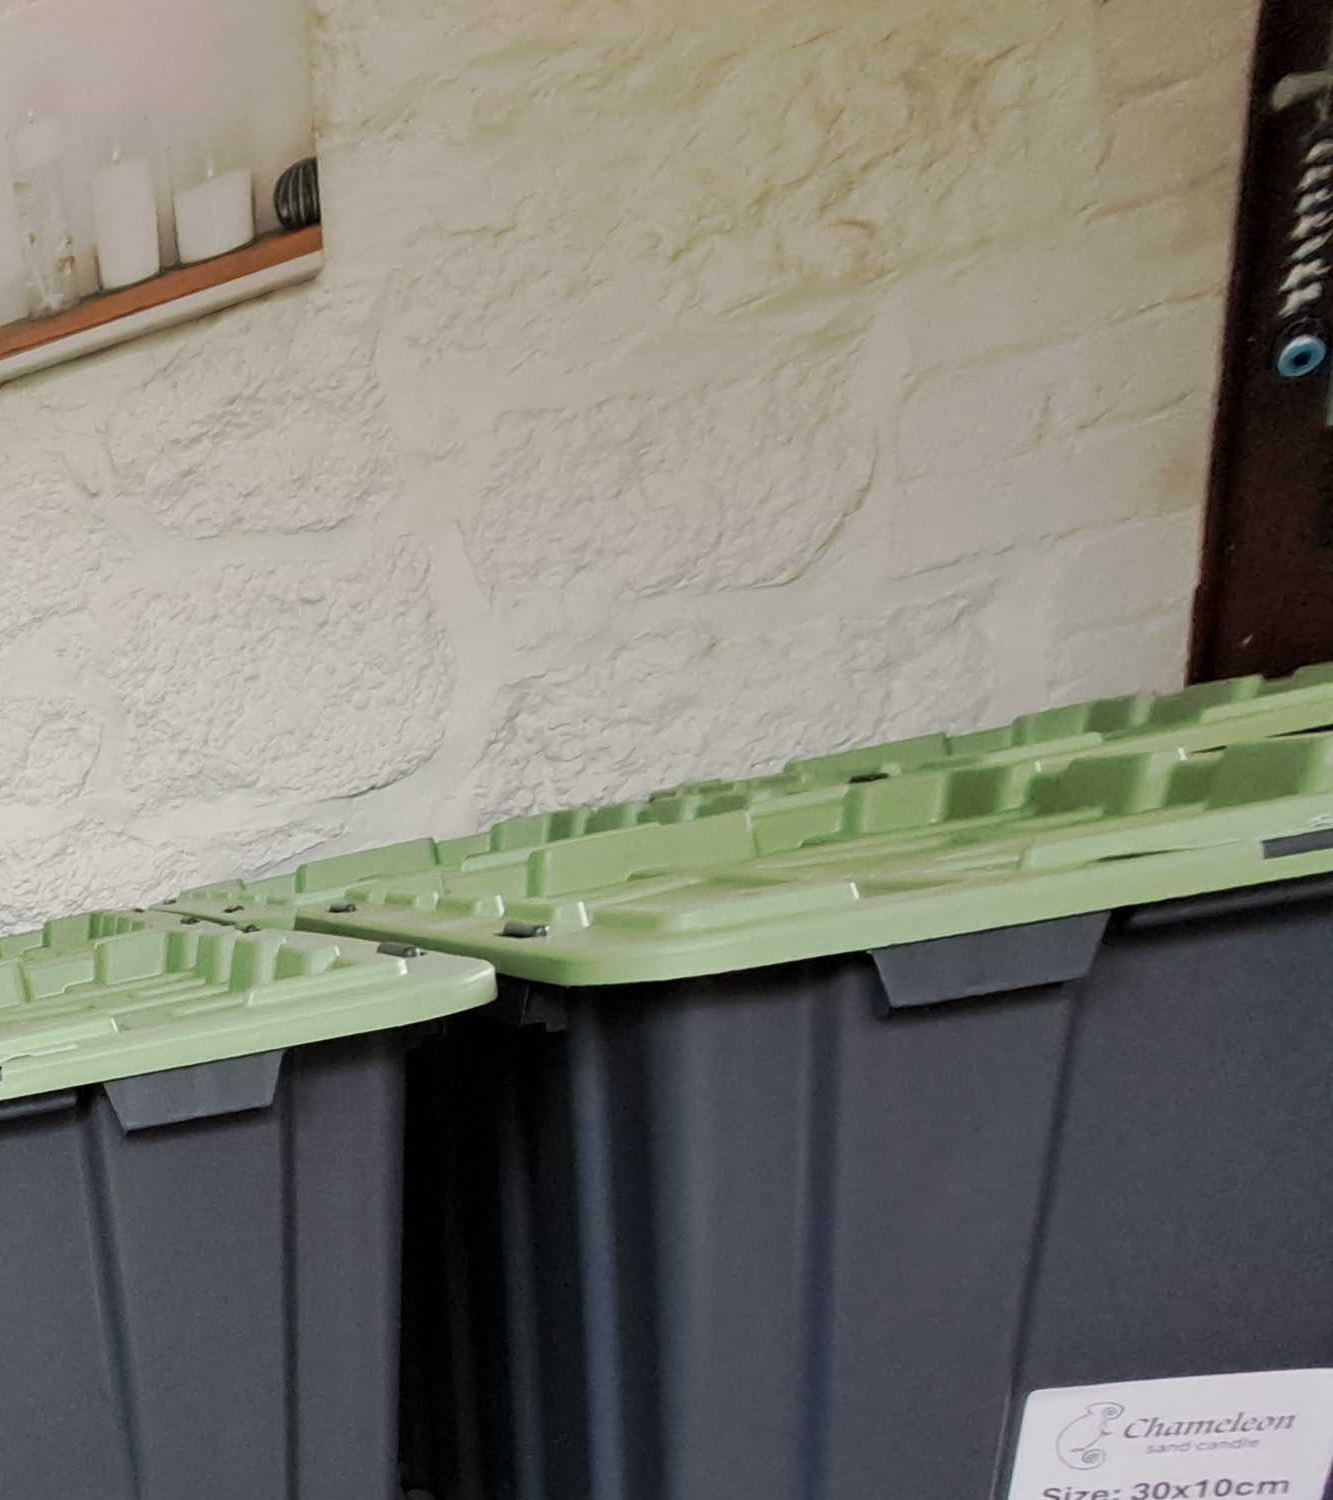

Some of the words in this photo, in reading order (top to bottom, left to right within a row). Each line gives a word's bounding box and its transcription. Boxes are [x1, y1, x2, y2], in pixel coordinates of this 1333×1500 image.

[1122, 1410, 1297, 1439] Chameleon
[1146, 1441, 1190, 1455] sand
[1130, 1477, 1290, 1500] 30x10cm
